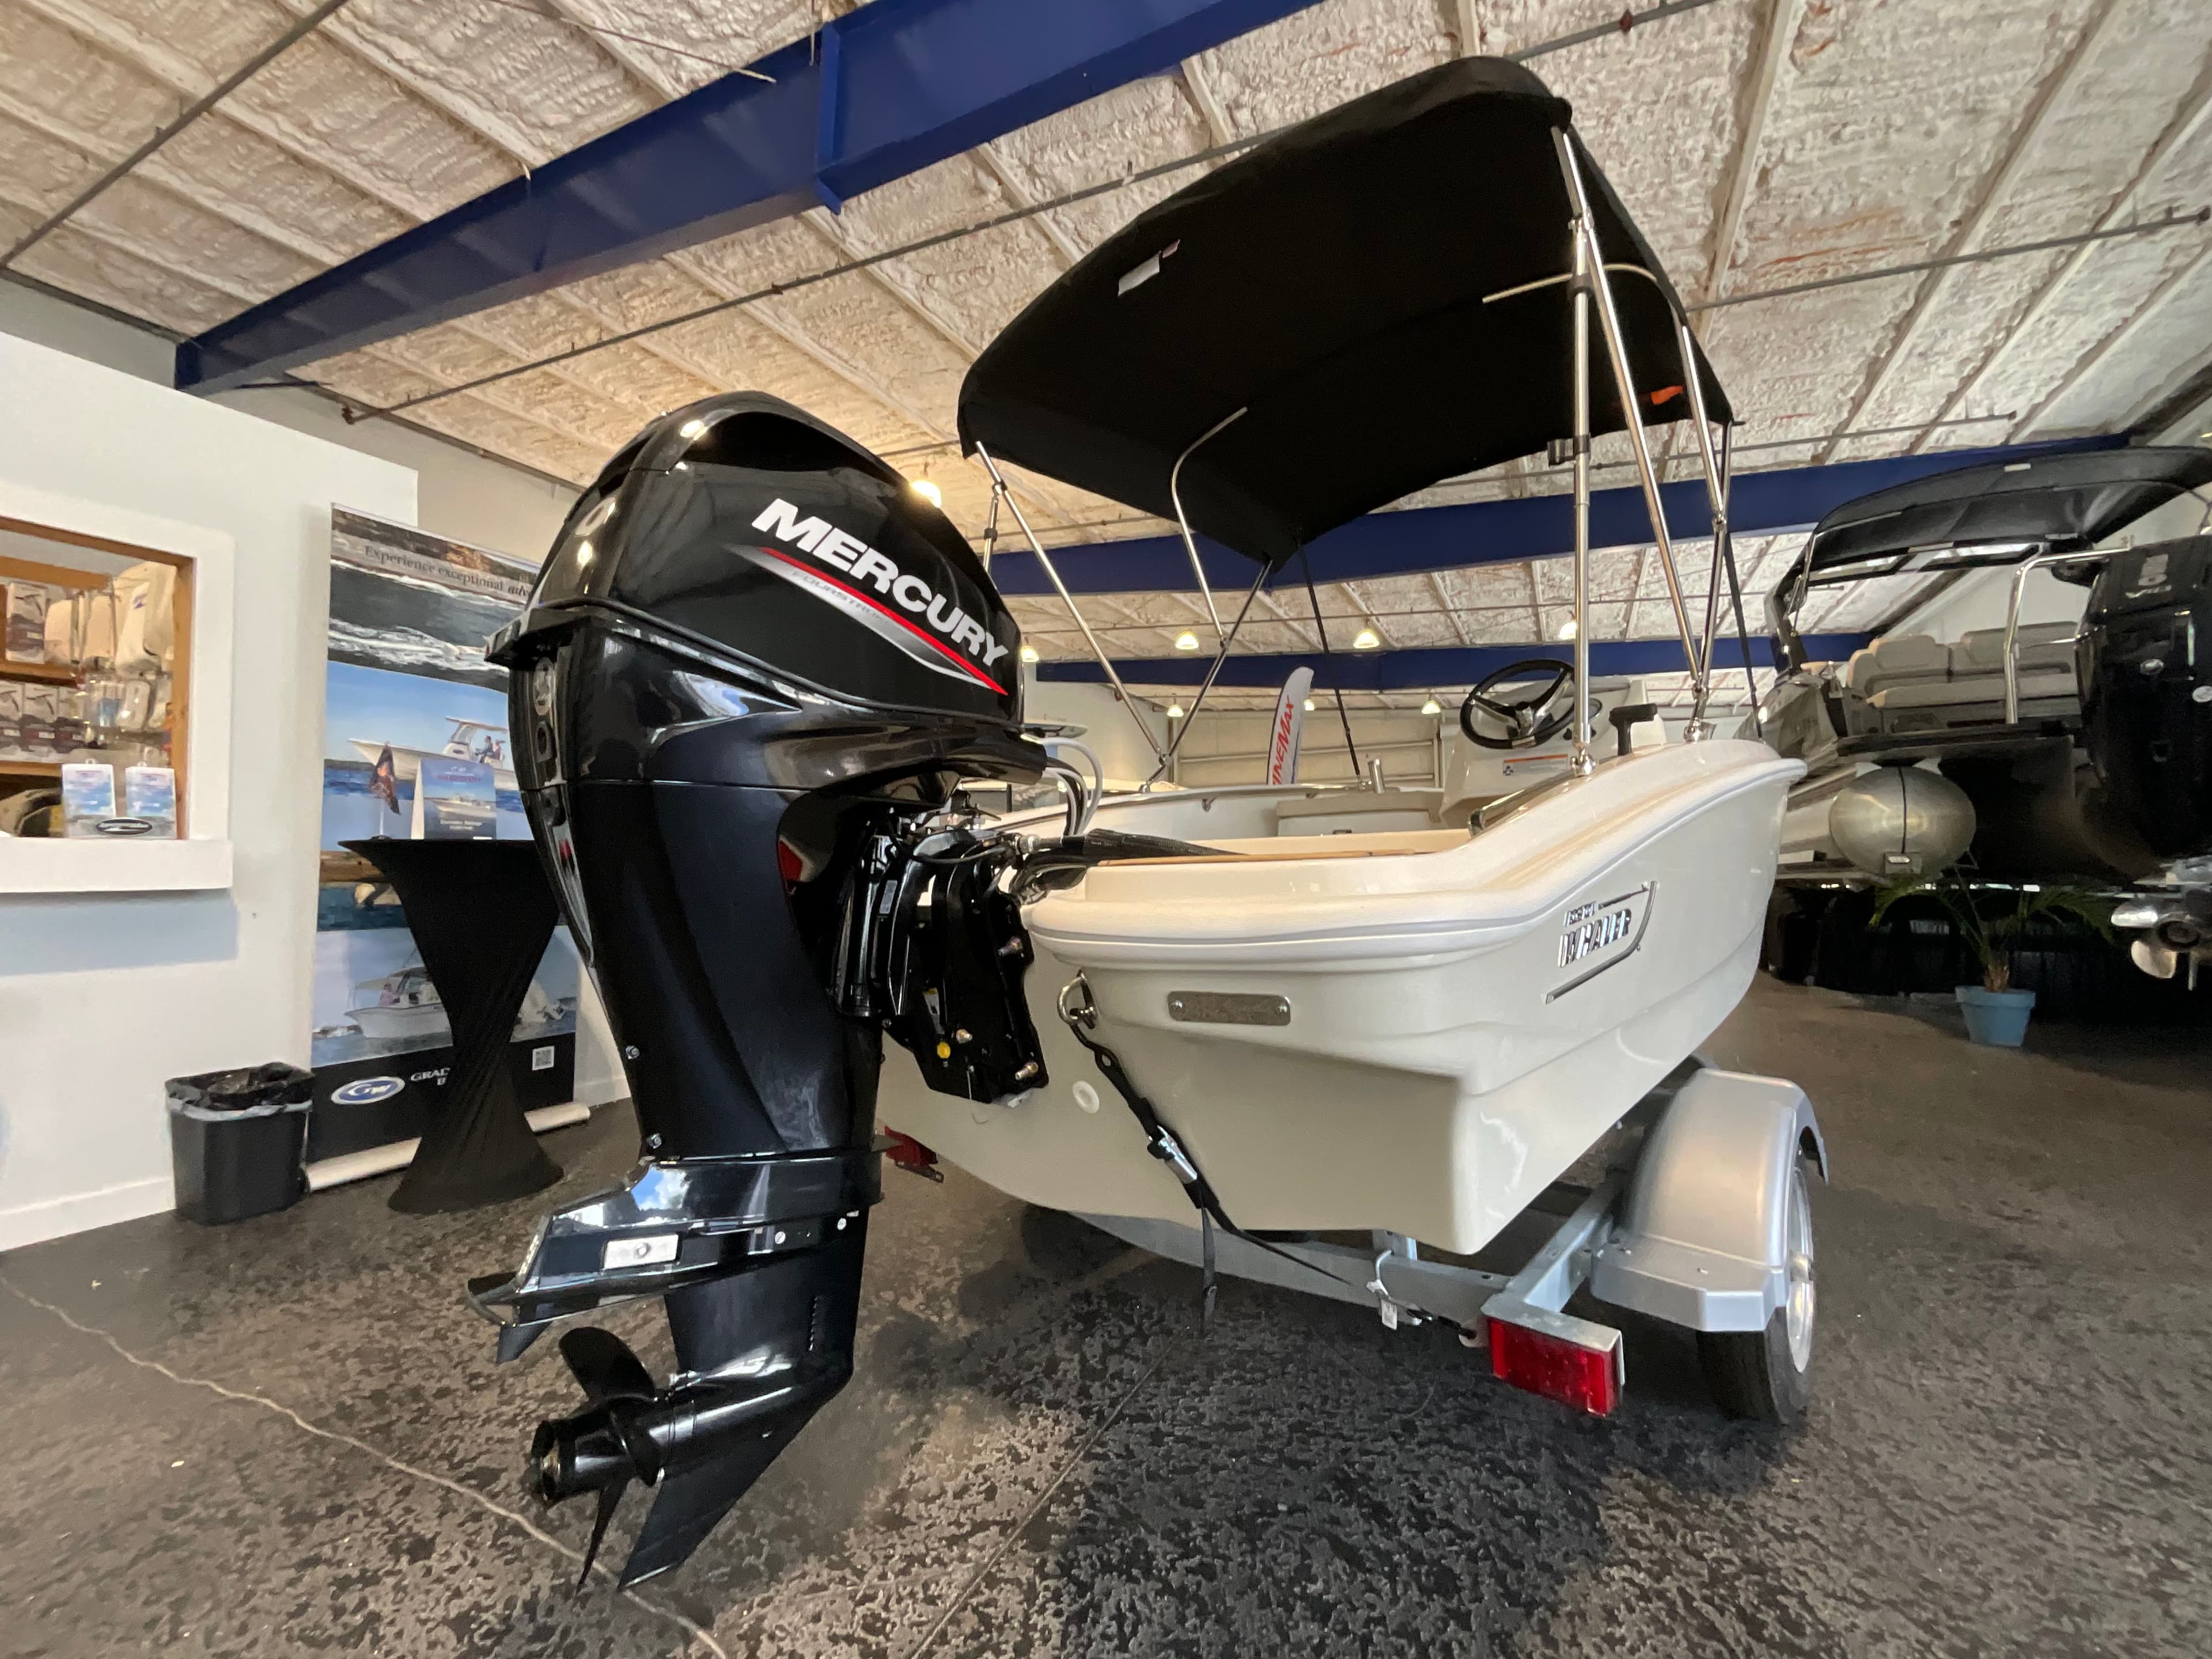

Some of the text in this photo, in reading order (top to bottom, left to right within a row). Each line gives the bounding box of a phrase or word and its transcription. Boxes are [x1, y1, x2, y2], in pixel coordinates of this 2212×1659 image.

[364, 545, 531, 597] Experience exceptional adv
[751, 498, 1009, 667] MERCURY
[1272, 694, 1294, 785] INEMAX
